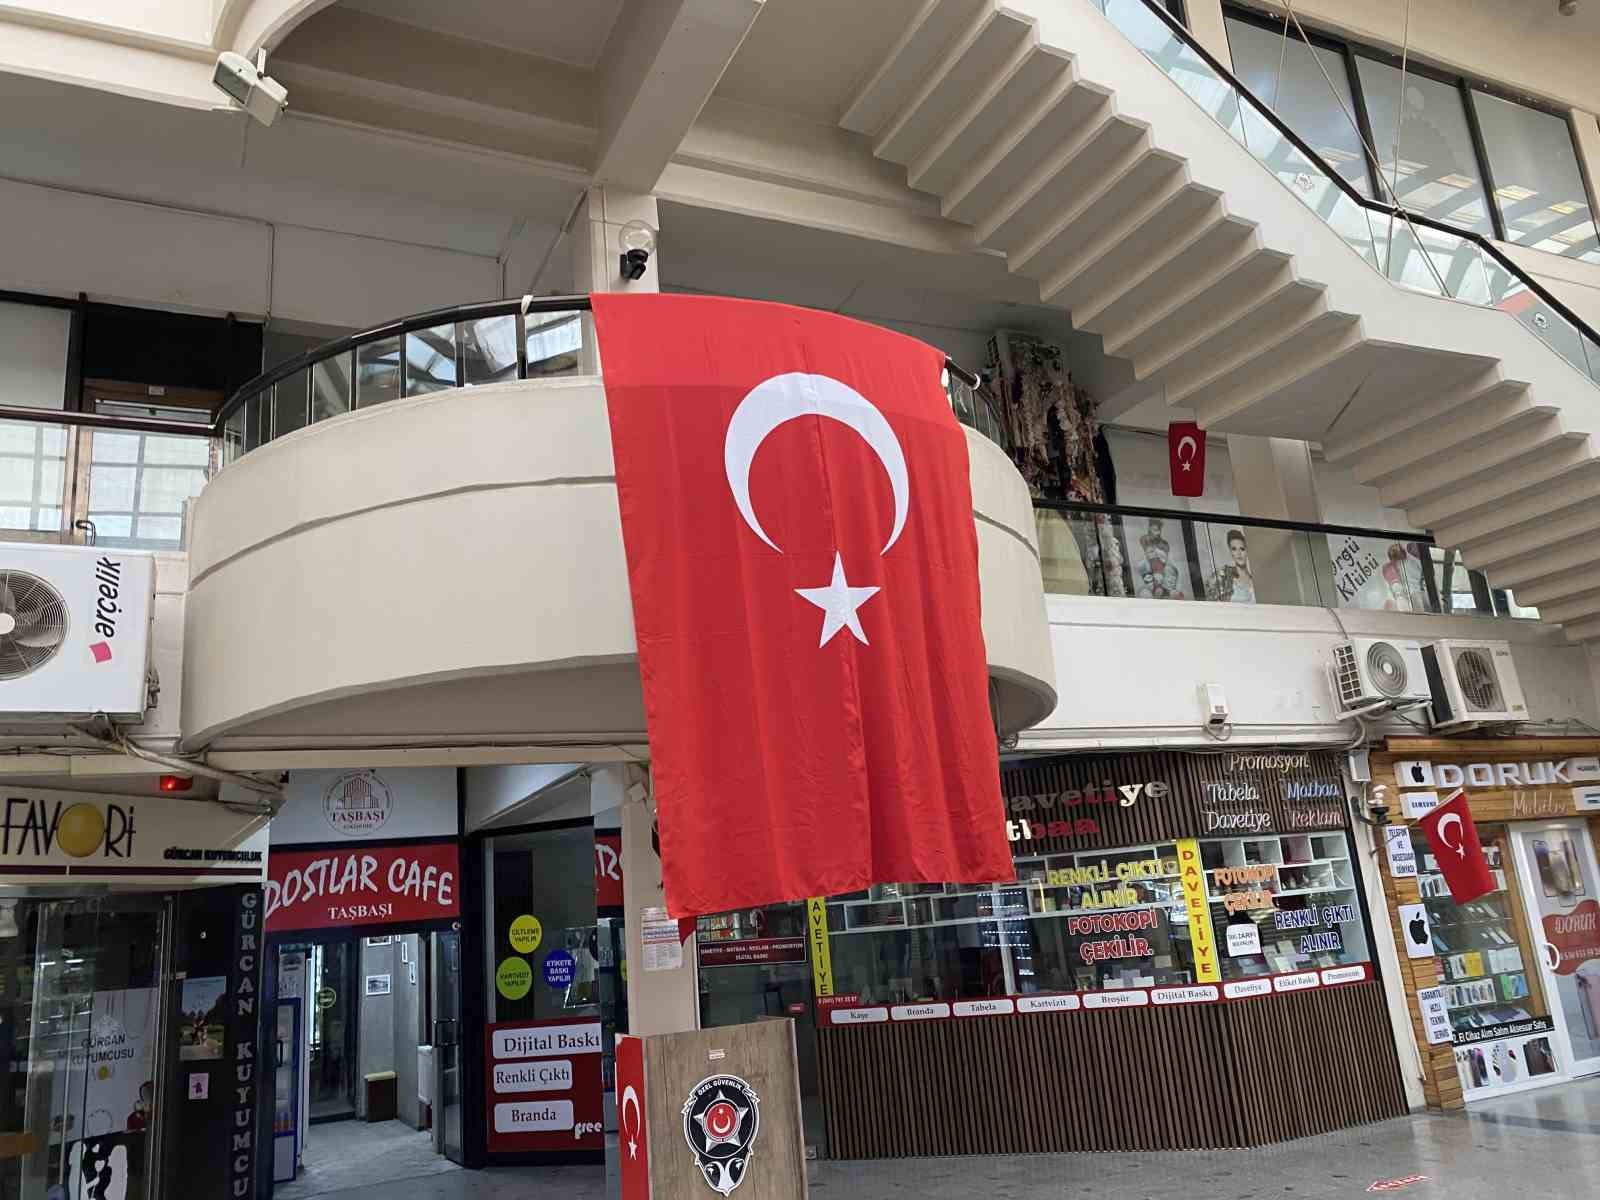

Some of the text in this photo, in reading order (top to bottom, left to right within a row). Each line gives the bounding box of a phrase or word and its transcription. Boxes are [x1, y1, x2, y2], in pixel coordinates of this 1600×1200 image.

[1336, 553, 1379, 602] Klübü
[95, 557, 122, 638] arçelik
[1436, 761, 1572, 787] DORUK
[1004, 779, 1168, 812] avetiye
[1207, 782, 1260, 803] Tabela
[1207, 809, 1272, 832] Davetiye
[1291, 809, 1344, 828] Reklam
[263, 854, 453, 919] DOSTLAR CAFE
[328, 903, 393, 920] TAŞBAŞI
[1182, 850, 1213, 974] DAVETİYE
[1274, 904, 1319, 930] RENKLİ
[237, 892, 257, 1016] GÜRCAN
[813, 901, 829, 995] AVETİYE
[1300, 932, 1341, 954] ALINIR
[906, 1007, 934, 1016] Branda
[970, 1003, 997, 1012] Tabela
[504, 1032, 600, 1055] Dijital Baskı
[496, 1067, 570, 1085] Renkli Çıktı
[511, 1107, 557, 1122] Branda
